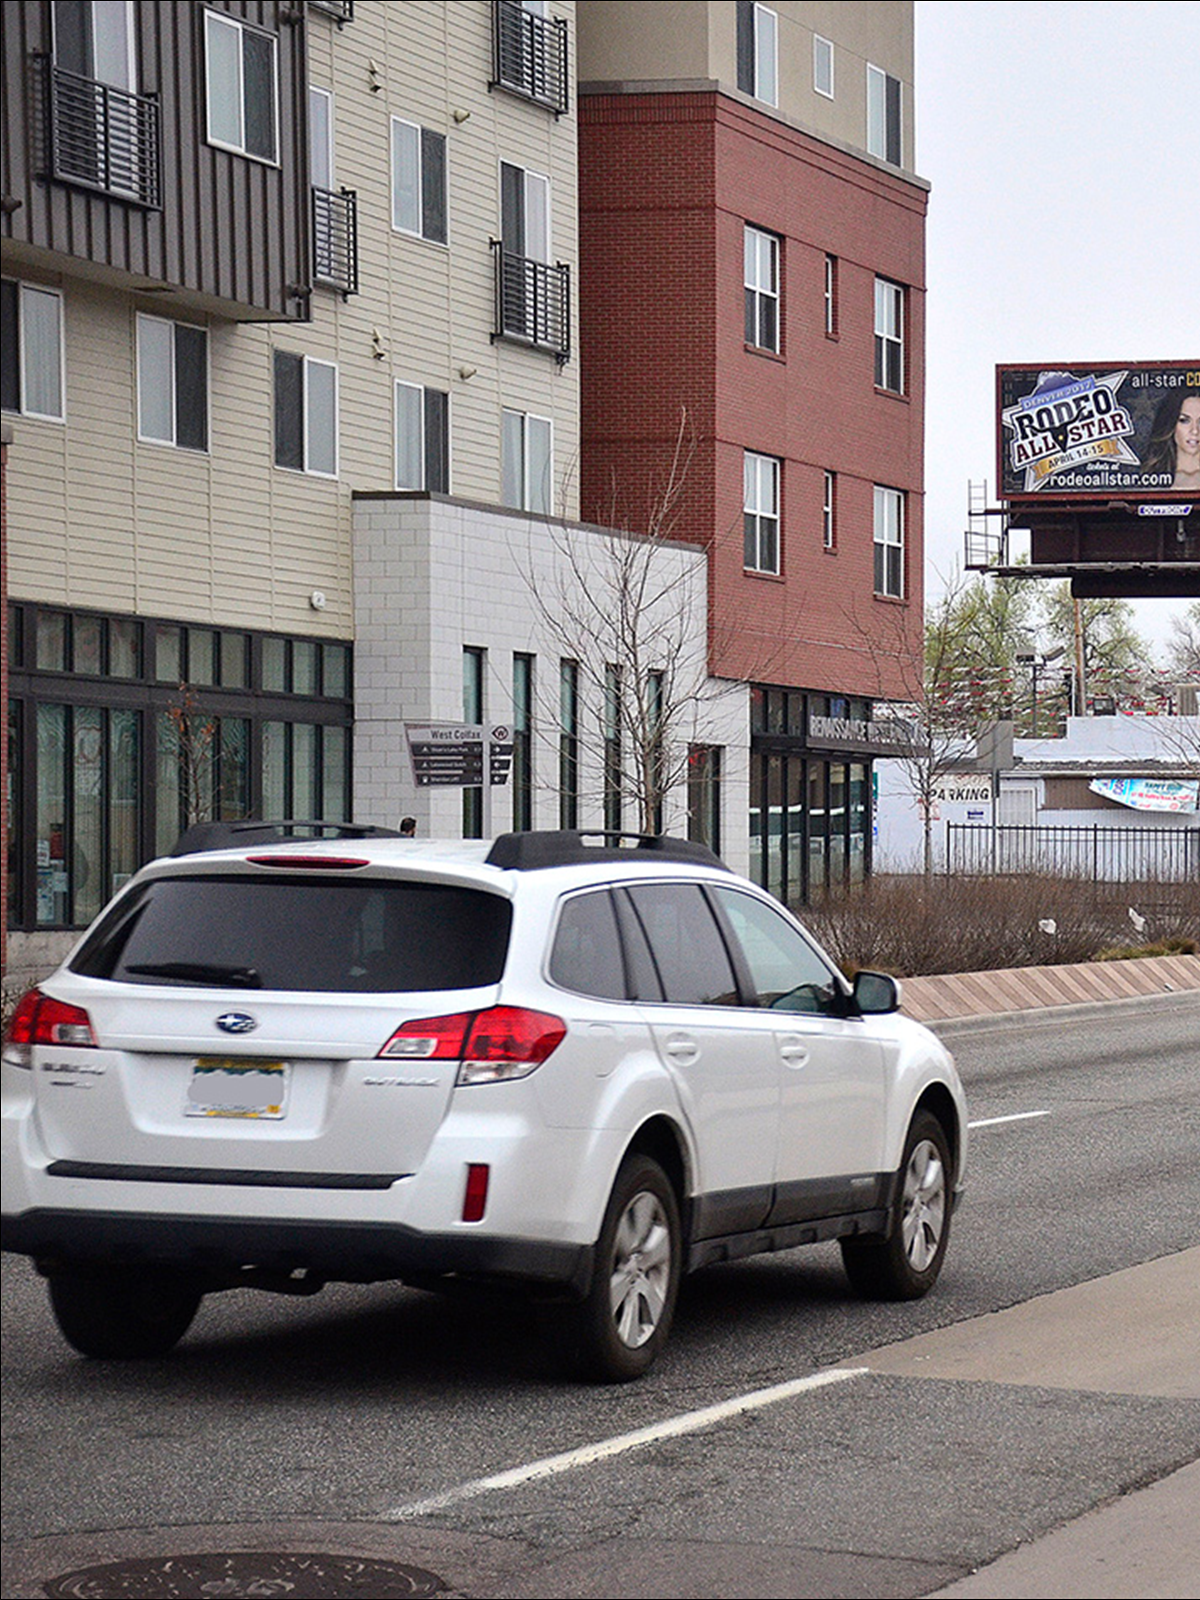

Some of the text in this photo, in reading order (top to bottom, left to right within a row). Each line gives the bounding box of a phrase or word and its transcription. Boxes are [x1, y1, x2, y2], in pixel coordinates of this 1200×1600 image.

[1132, 373, 1185, 387] all-star
[1015, 389, 1113, 441] RODEO
[1016, 413, 1127, 463] ALL STAR
[1048, 454, 1074, 470] APRIL
[1050, 471, 1172, 486] rodeoallstar.com
[431, 729, 481, 740] West Colfax
[930, 788, 989, 801] PARKING
